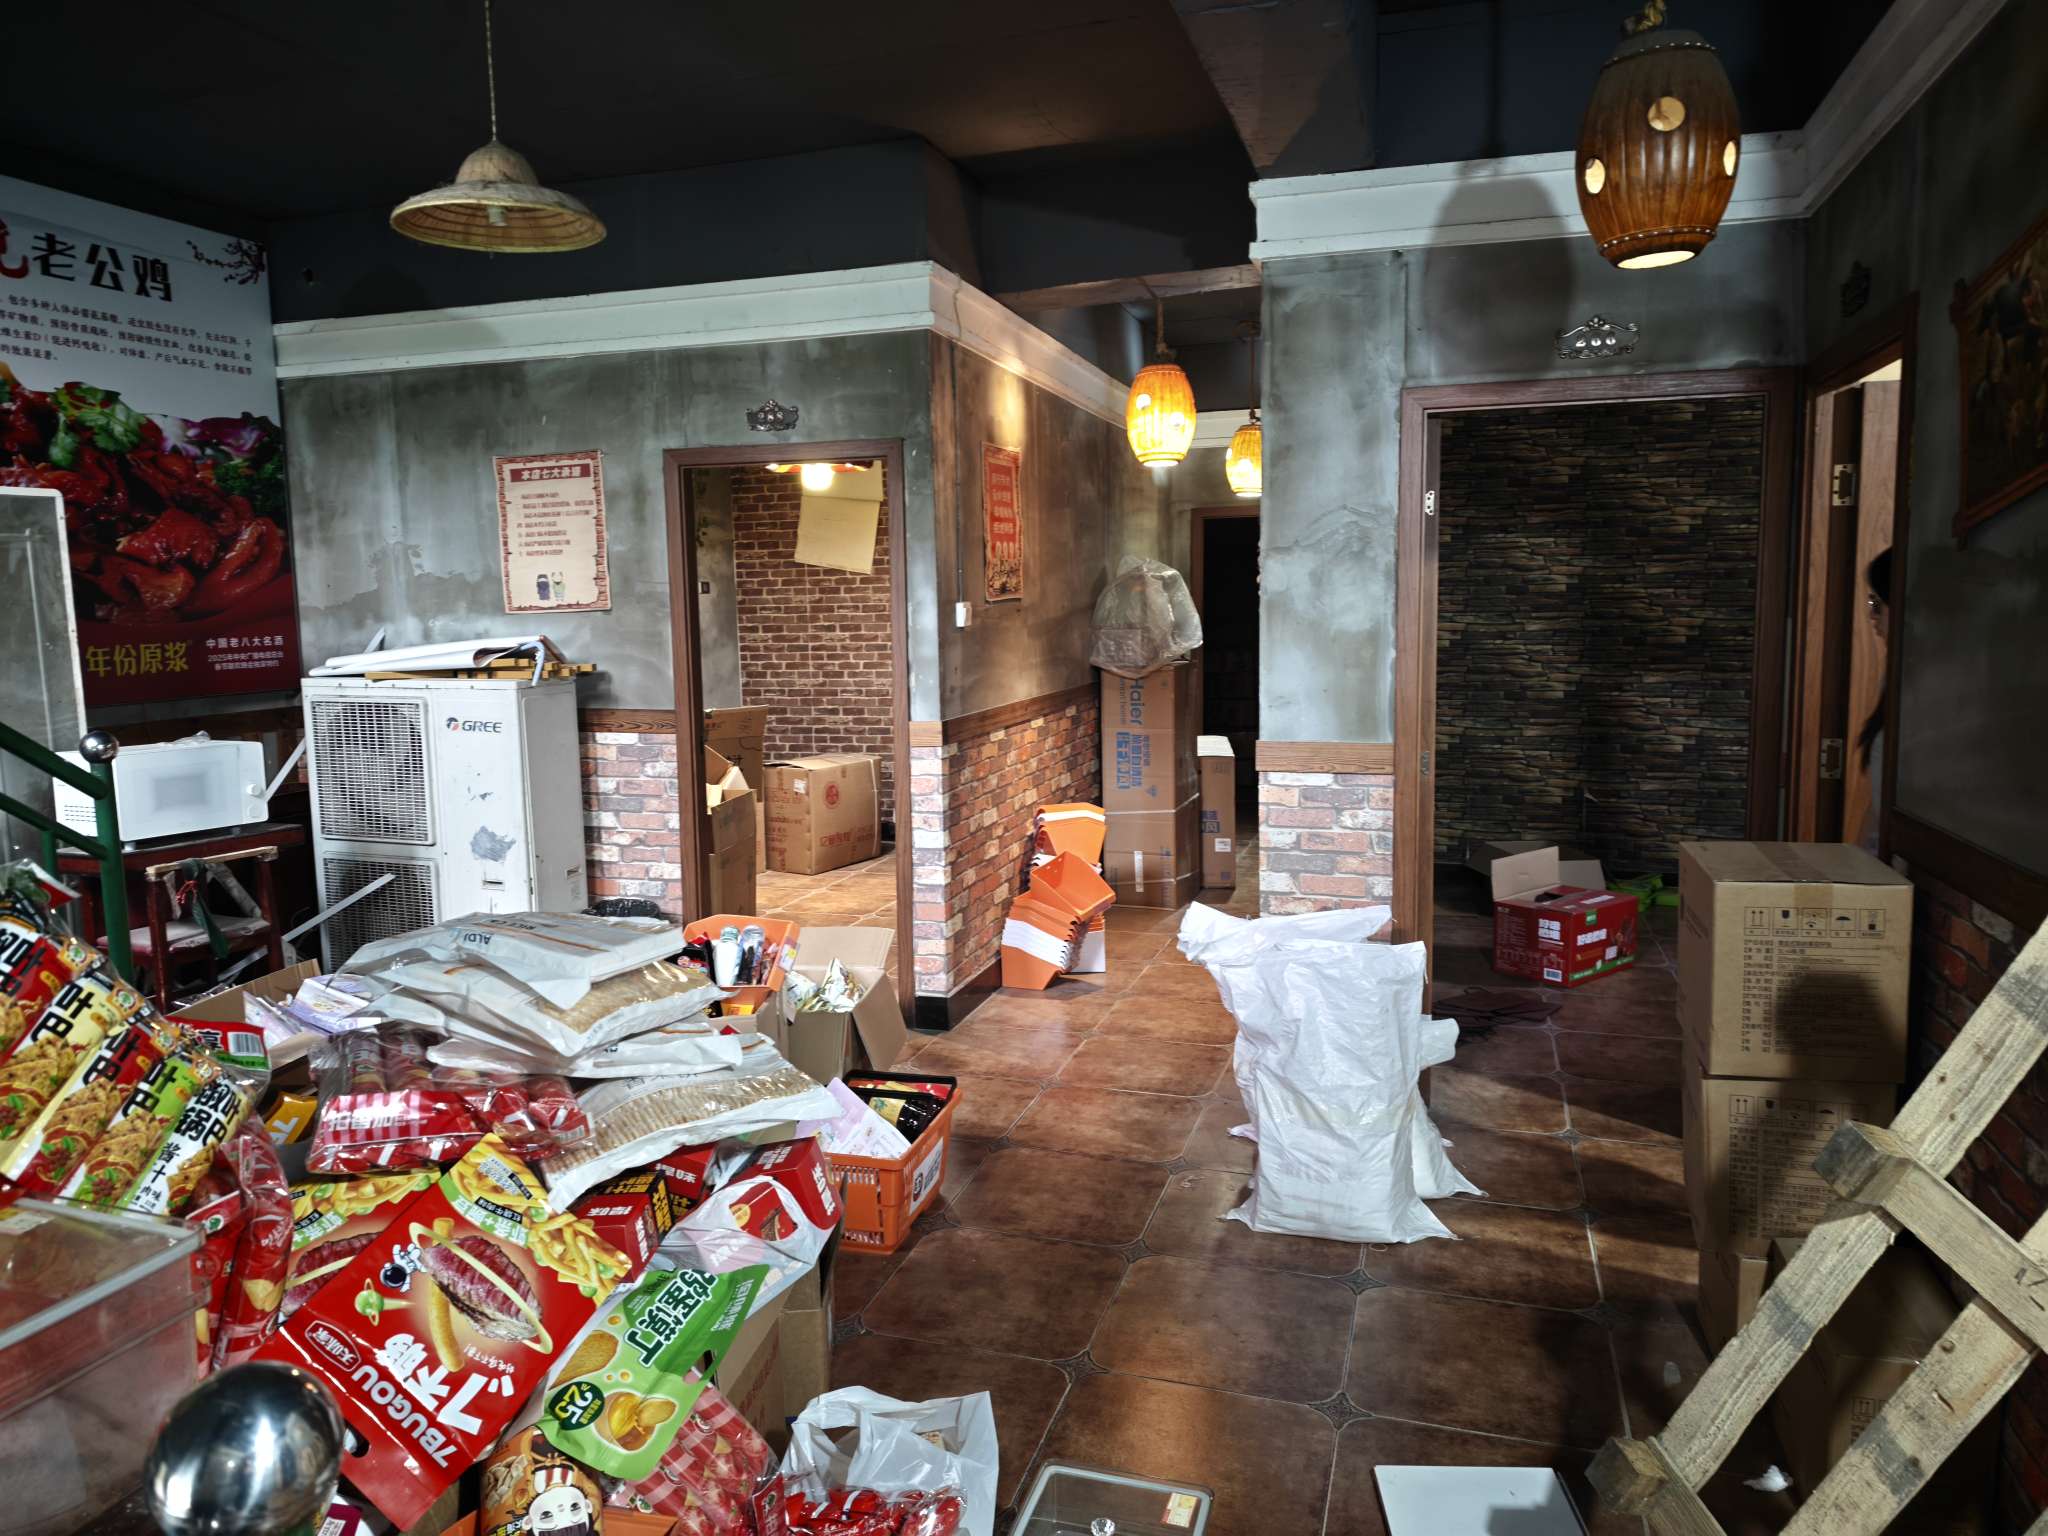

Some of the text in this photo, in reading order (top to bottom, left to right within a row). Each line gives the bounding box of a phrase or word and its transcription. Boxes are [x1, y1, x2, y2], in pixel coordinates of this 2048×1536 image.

[31, 232, 173, 302] 老公鸡
[85, 641, 189, 678] 年份原浆
[205, 635, 284, 650] 中国老八大名酒
[462, 720, 503, 734] GREE
[352, 1364, 457, 1468] 7BUGOU
